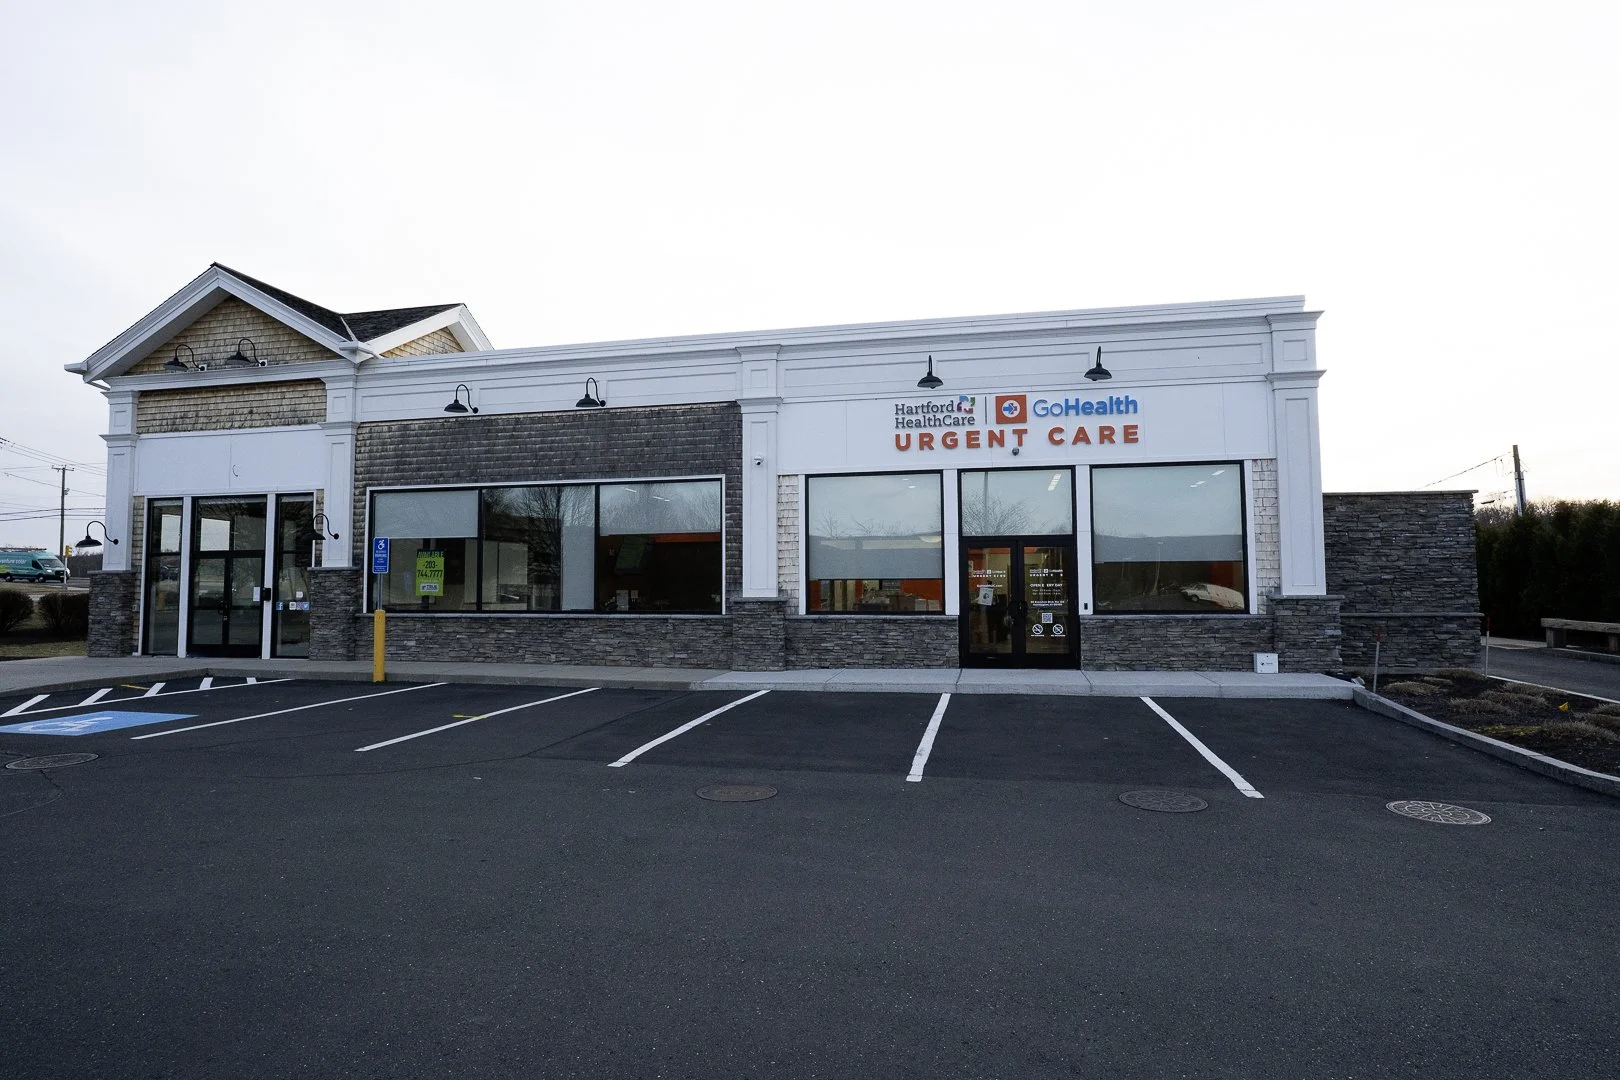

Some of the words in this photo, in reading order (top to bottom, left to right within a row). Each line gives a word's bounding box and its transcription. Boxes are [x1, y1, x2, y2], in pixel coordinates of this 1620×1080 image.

[894, 400, 955, 416] Hartford
[1033, 395, 1138, 417] GoHealth
[895, 414, 976, 429] HealthCare
[895, 428, 1028, 451] URGENT
[1048, 424, 1139, 446] CARE
[417, 569, 443, 578] 744.7777
